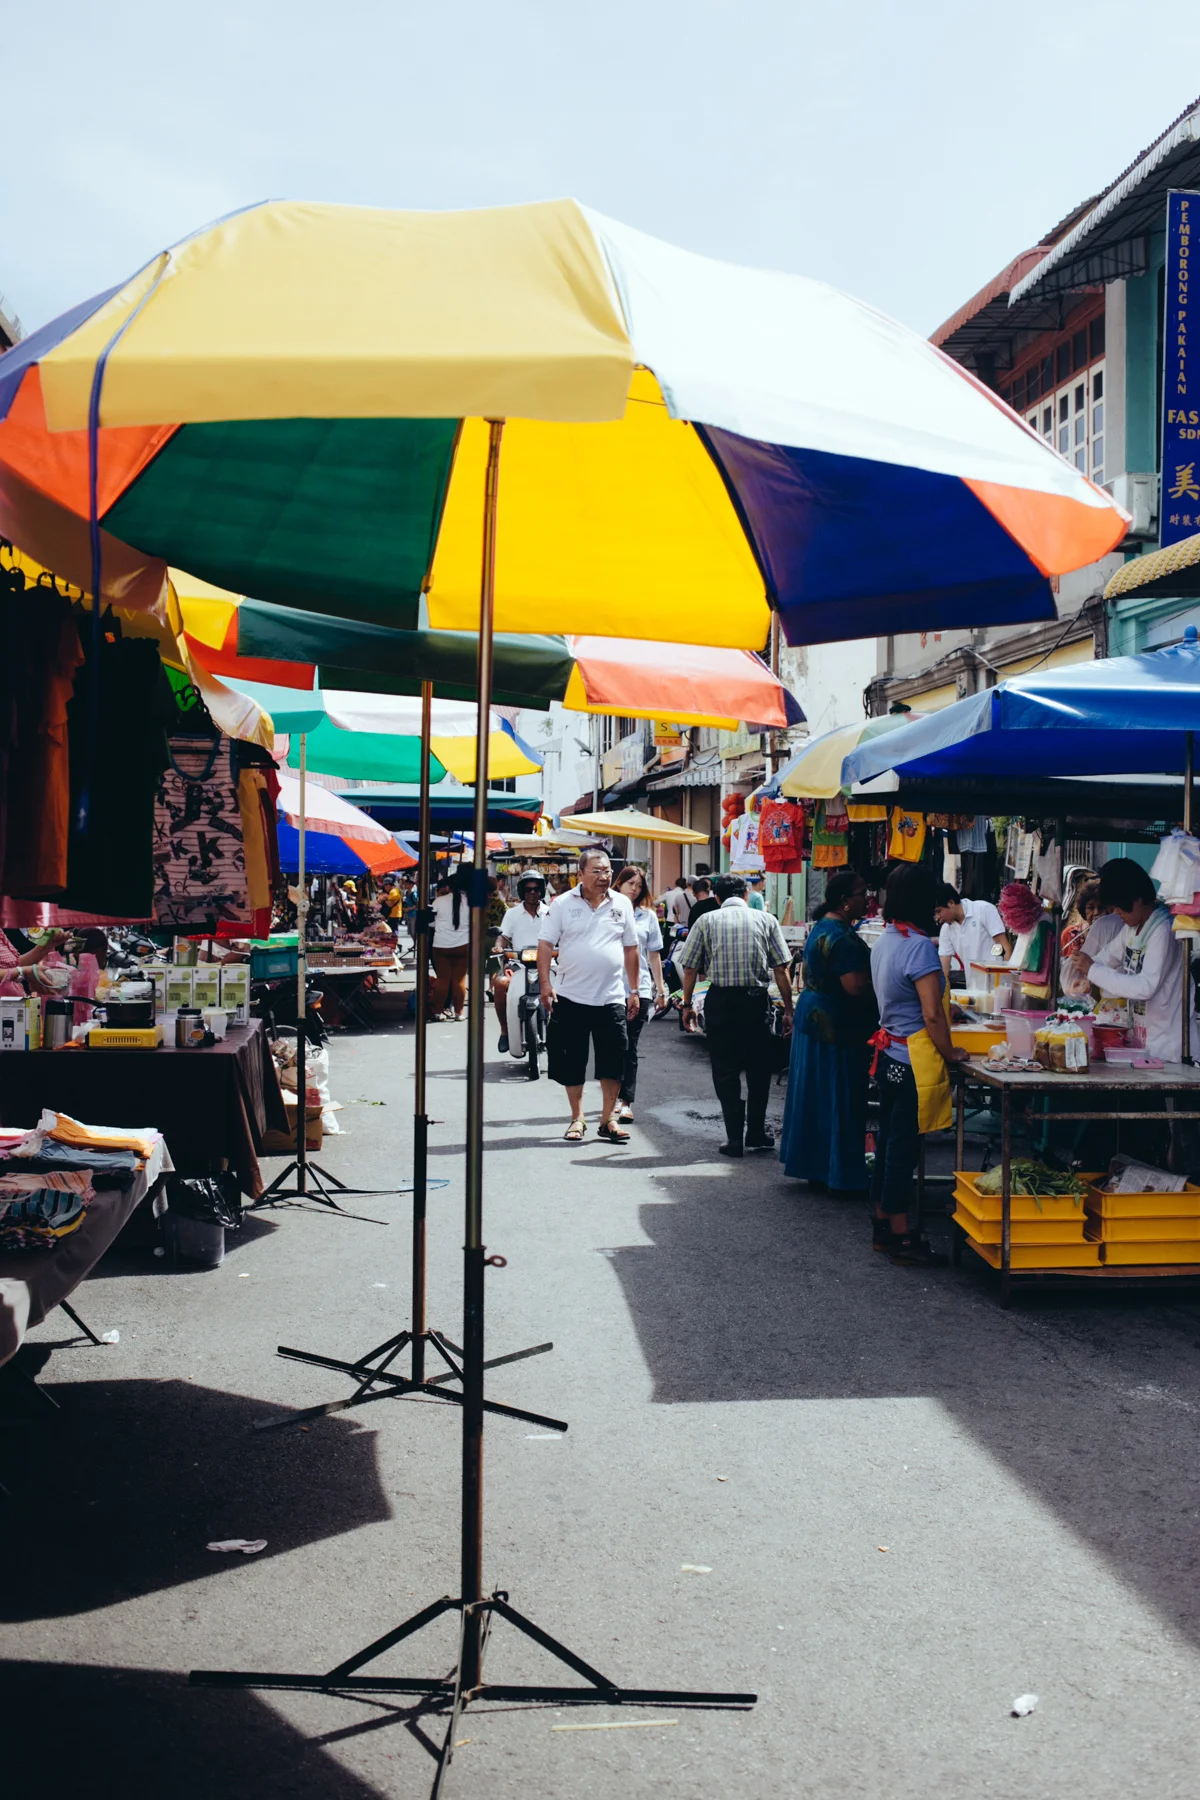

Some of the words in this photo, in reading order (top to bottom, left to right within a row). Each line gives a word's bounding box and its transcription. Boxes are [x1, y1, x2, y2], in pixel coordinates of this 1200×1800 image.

[1178, 200, 1190, 305] PEMBORONG
[1177, 310, 1188, 395] PAKAIAN
[1167, 409, 1199, 425] FAS
[1168, 462, 1200, 501] 美
